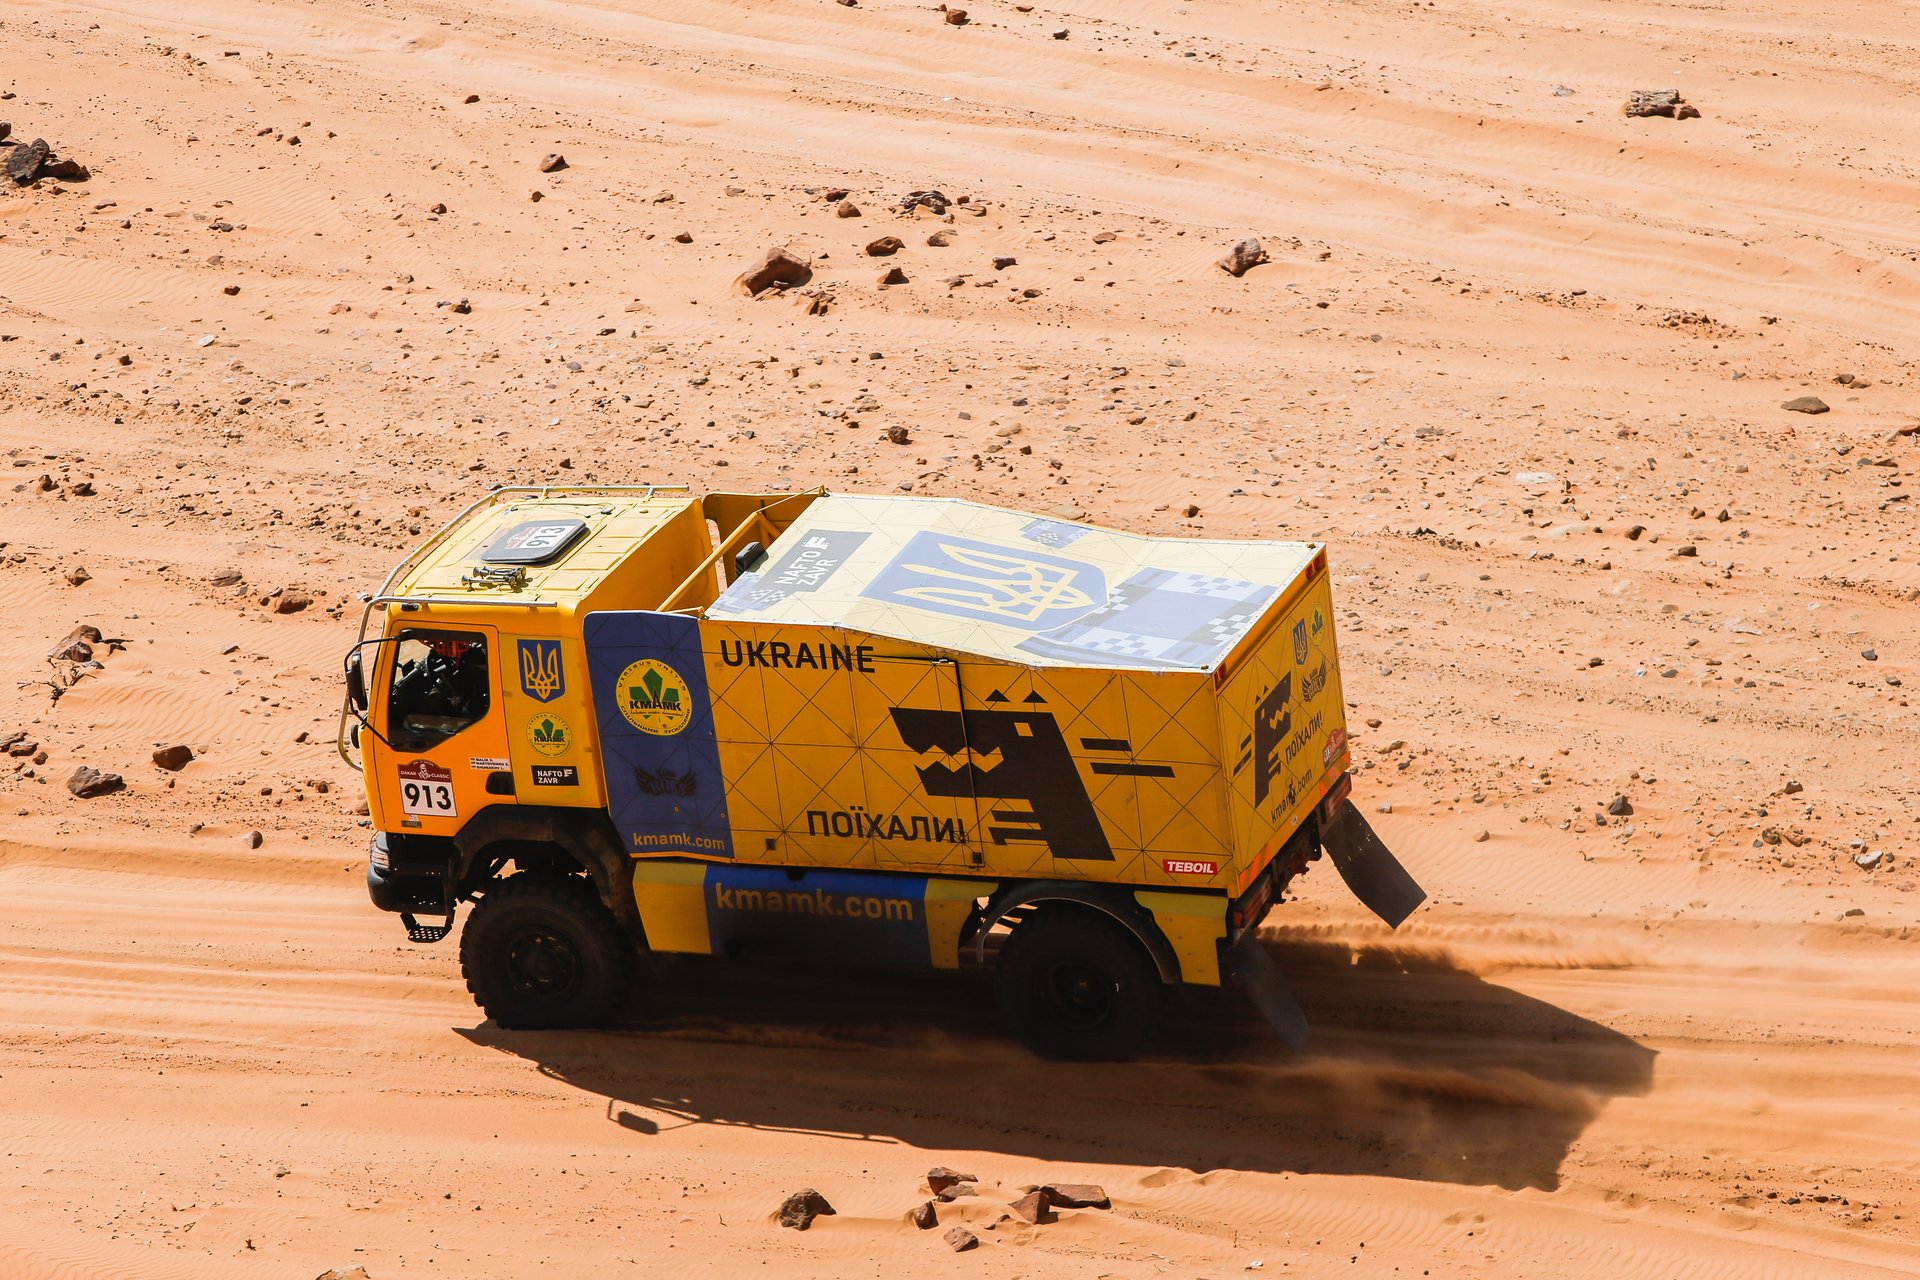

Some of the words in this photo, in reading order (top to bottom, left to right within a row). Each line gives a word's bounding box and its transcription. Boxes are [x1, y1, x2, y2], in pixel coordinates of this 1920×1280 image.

[526, 527, 566, 547] 913
[774, 550, 822, 585] NAFTO
[795, 559, 838, 586] ZAVR
[720, 639, 875, 674] UKRAINE
[629, 694, 682, 712] KMAMK
[1285, 710, 1323, 765] ПОЇХАЛИ!
[404, 782, 452, 811] 913
[806, 804, 966, 844] ПОЇХАЛИ!
[633, 832, 725, 851] kmamk.com
[1167, 861, 1214, 874] TEBOIL
[715, 882, 914, 921] kmamk.com
